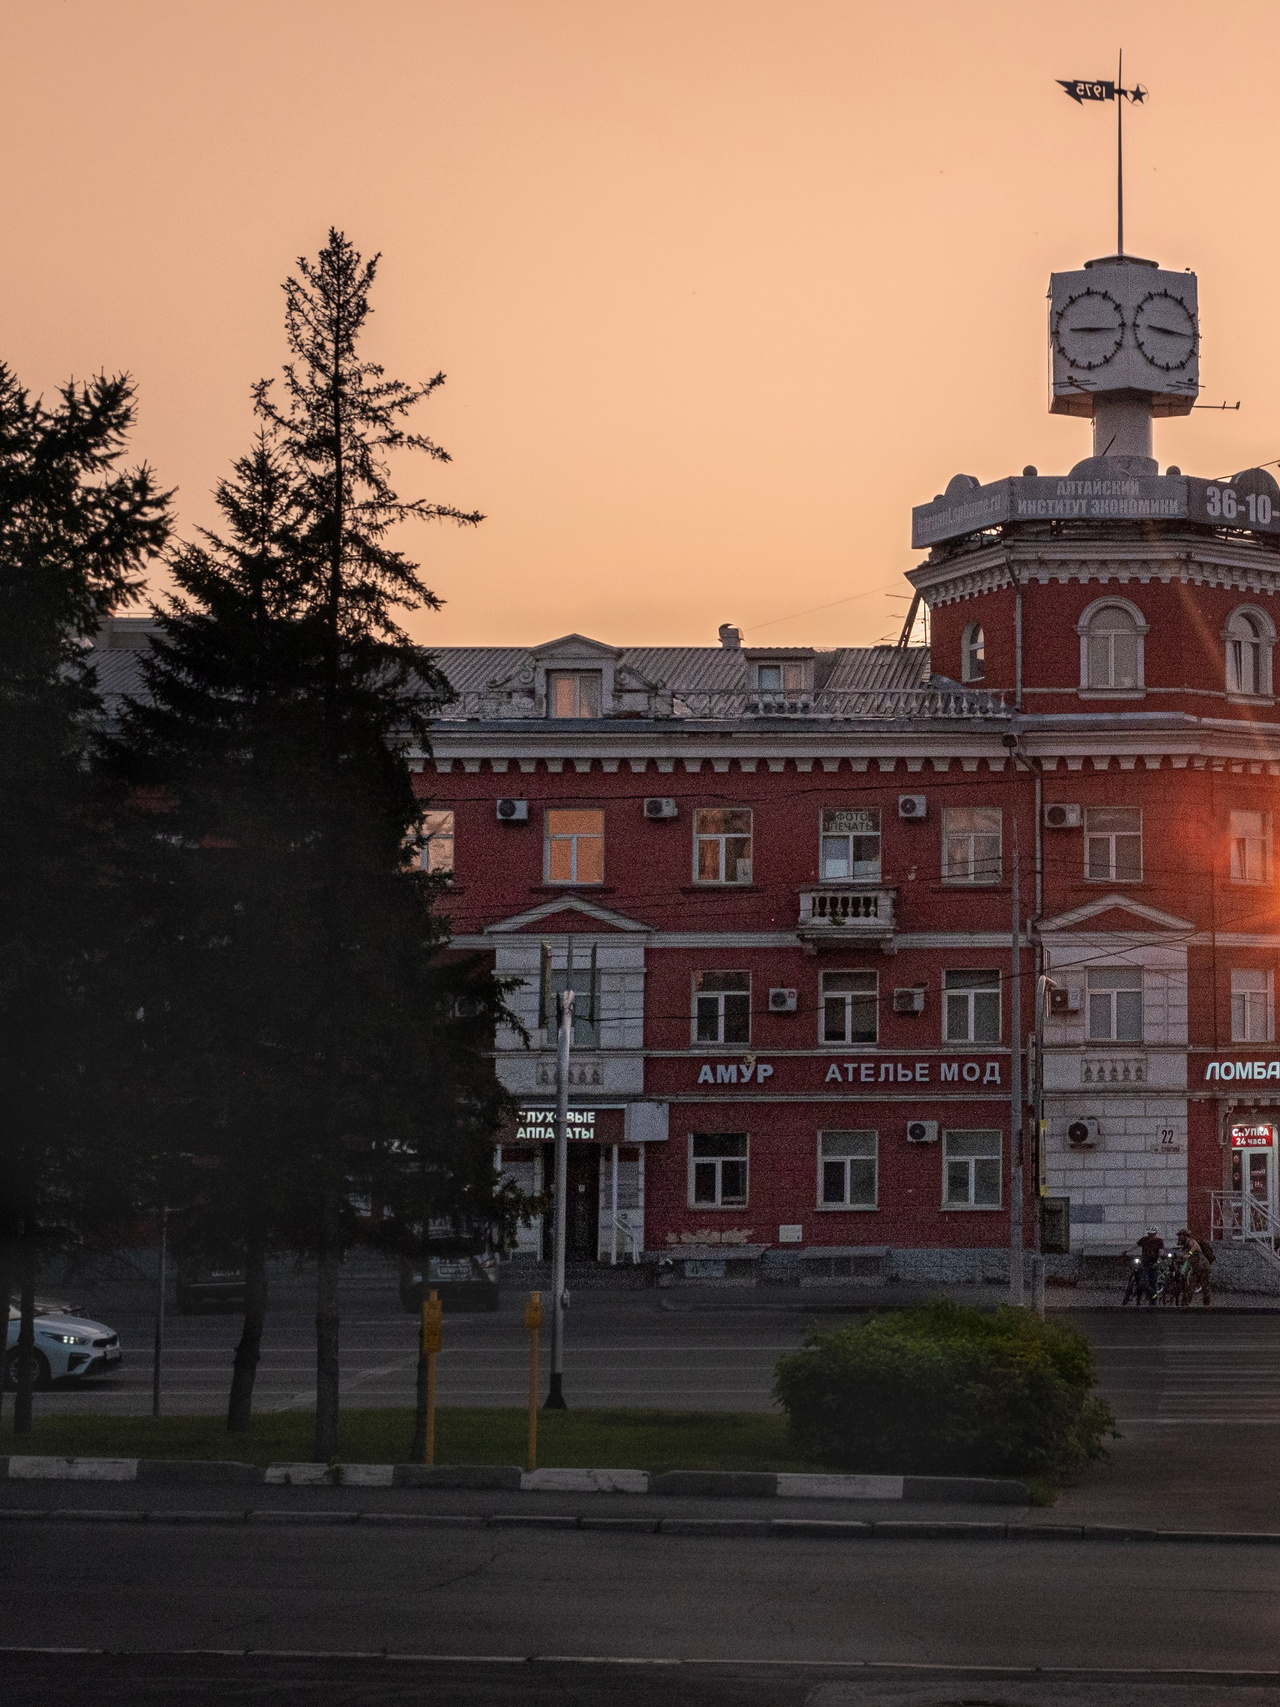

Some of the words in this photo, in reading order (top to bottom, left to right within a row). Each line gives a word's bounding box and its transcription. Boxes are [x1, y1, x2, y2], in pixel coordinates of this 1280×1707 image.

[1018, 500, 1088, 515] ИНСТИТУТ
[836, 812, 868, 821] ФОТО
[697, 1064, 774, 1084] АМУР
[824, 1063, 930, 1082] АТЕЛЬЕ
[940, 1062, 1001, 1084] МОД
[516, 1111, 595, 1123] ЛУХВЫЕ
[516, 1127, 594, 1139] АППААТЫ
[1162, 1129, 1174, 1144] 22
